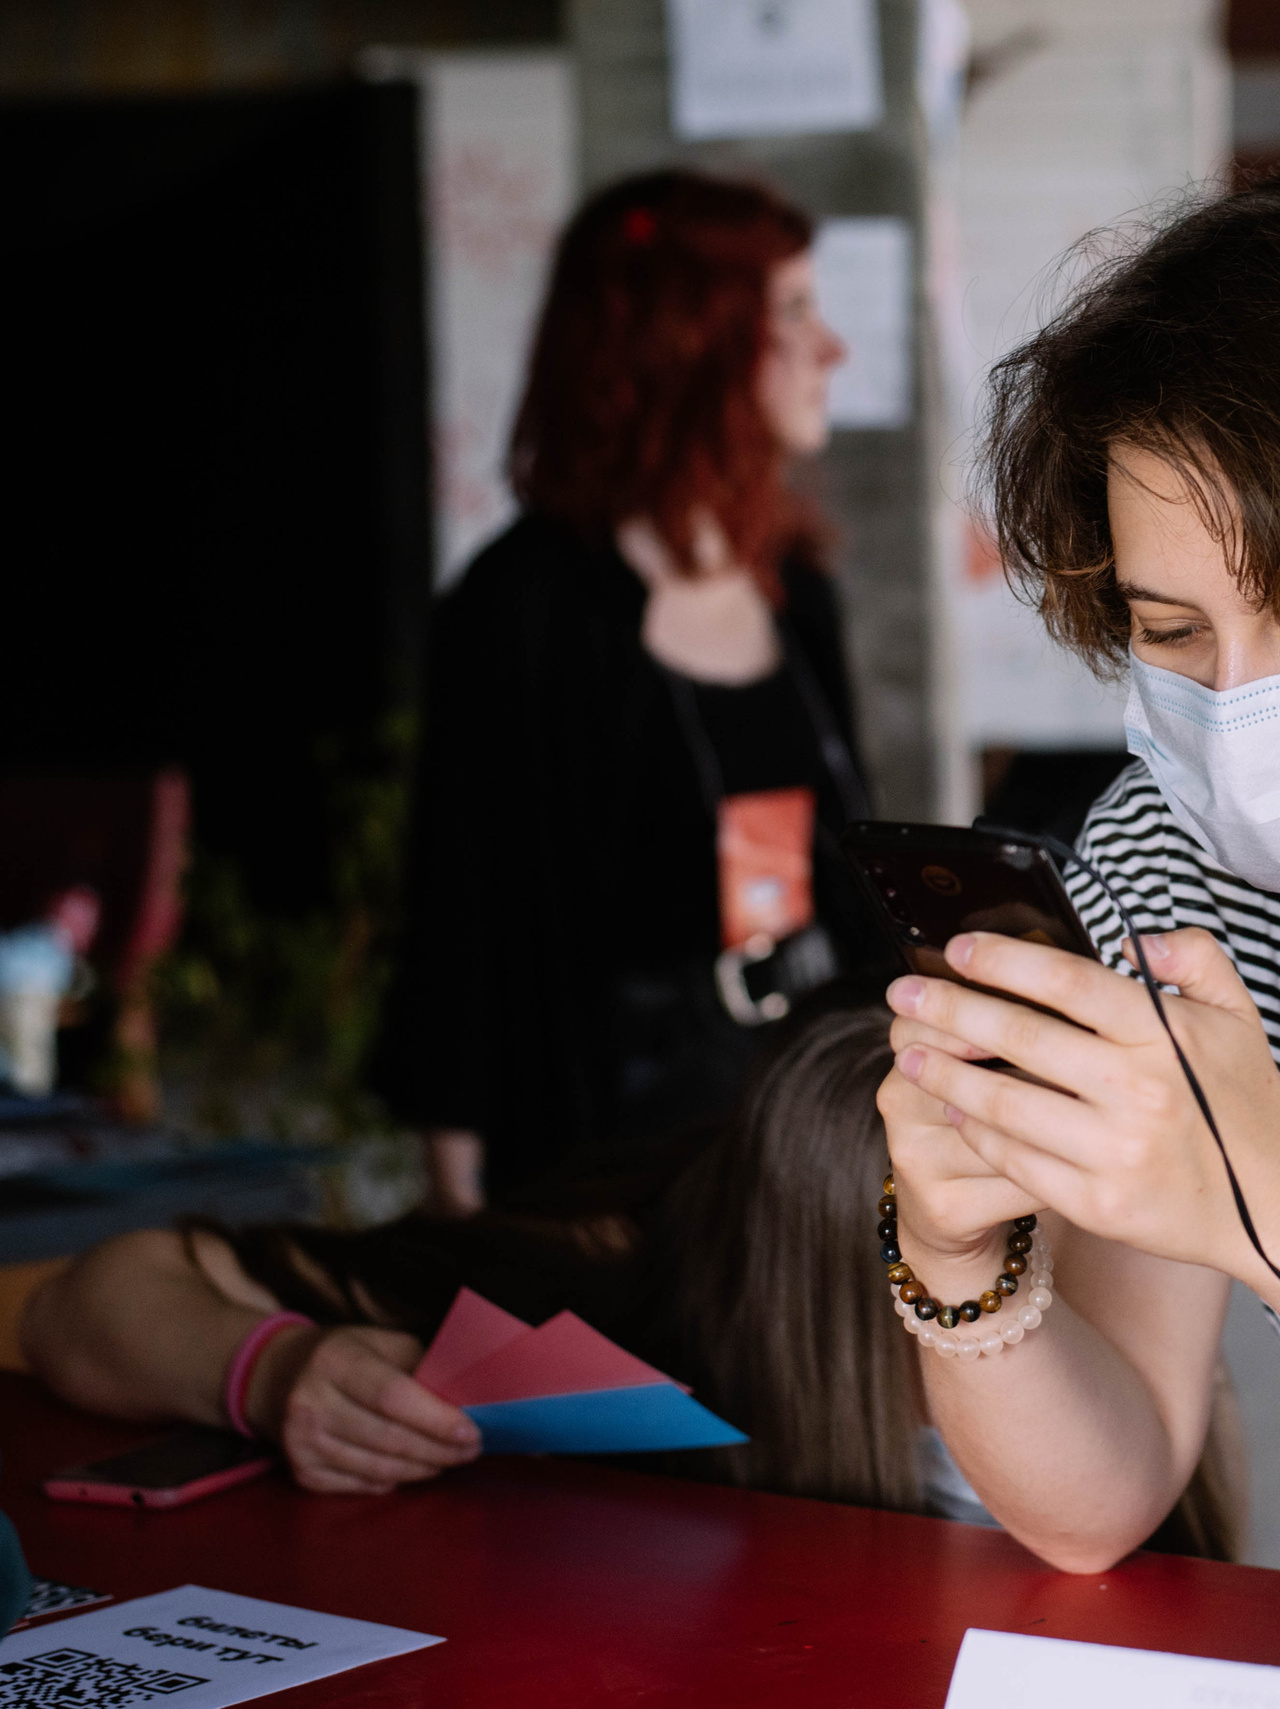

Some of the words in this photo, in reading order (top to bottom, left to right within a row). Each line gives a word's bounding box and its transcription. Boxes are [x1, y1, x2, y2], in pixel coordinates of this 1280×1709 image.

[123, 1626, 218, 1652] бери
[215, 1646, 285, 1664] тут
[177, 1616, 319, 1650] билеты
